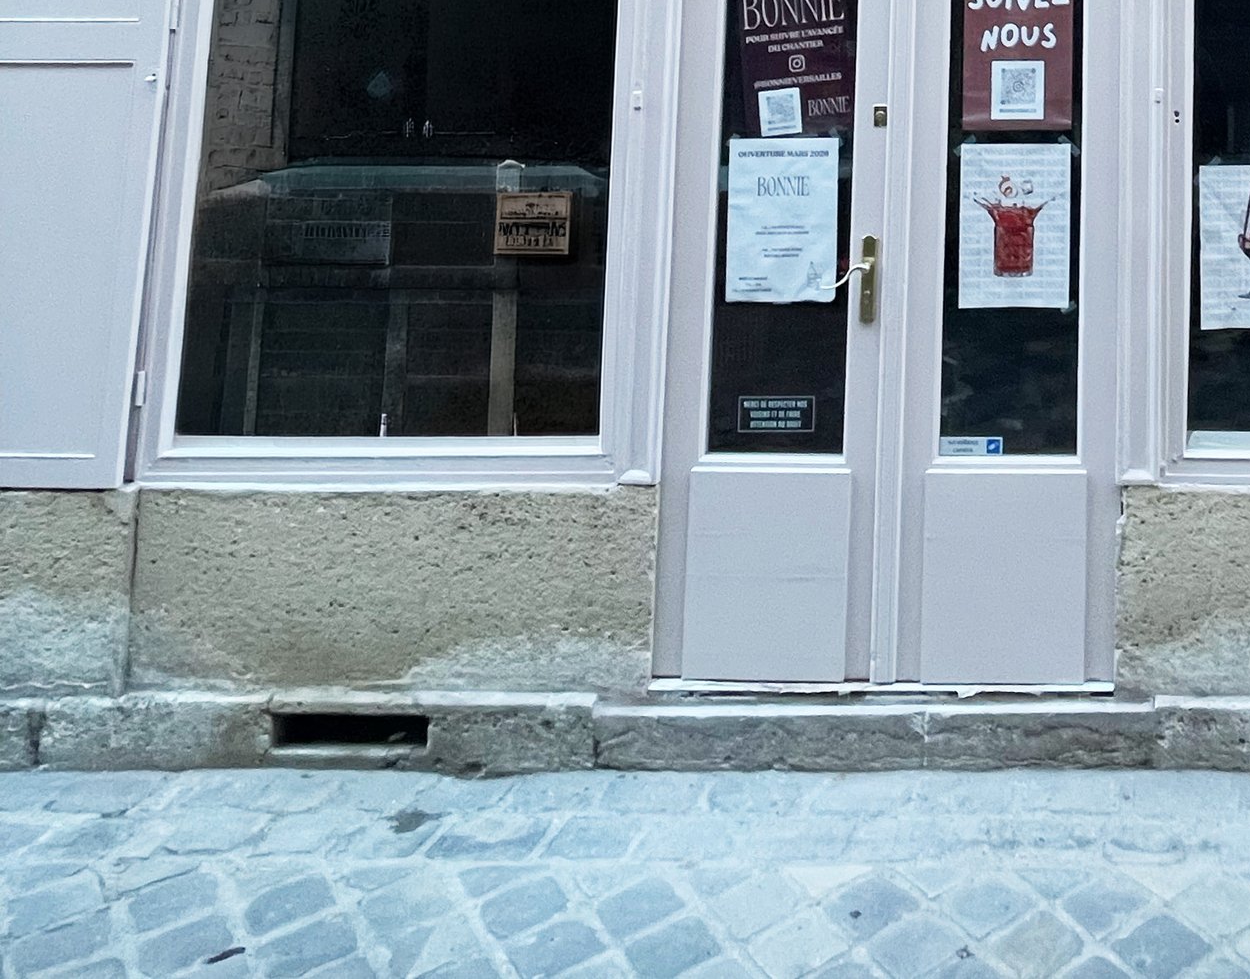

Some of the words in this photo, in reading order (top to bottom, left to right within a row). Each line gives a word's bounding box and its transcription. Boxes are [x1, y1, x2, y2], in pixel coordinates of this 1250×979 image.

[746, 34, 769, 44] POUR
[769, 30, 800, 41] SUIVRE
[980, 23, 1057, 52] NOUS
[768, 44, 781, 53] DU
[781, 40, 824, 51] CHANTIER
[807, 95, 850, 117] BONNIE
[738, 150, 785, 158] OUVERTURE
[787, 150, 808, 158] MARS
[757, 176, 810, 197] BONNIE
